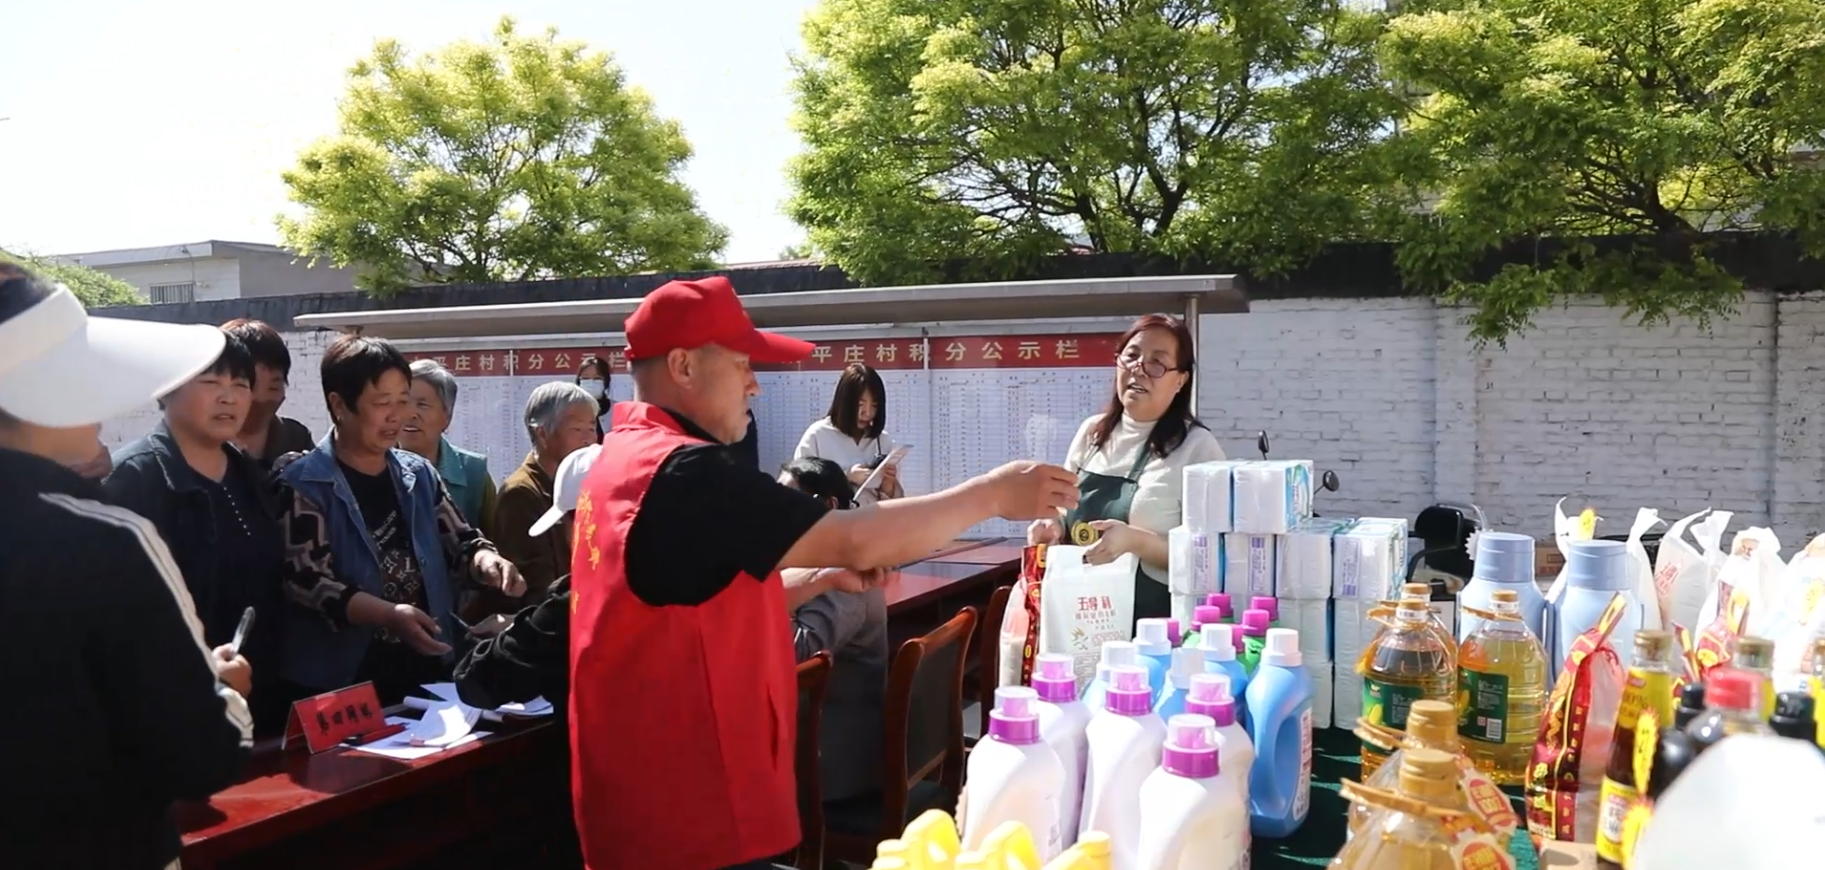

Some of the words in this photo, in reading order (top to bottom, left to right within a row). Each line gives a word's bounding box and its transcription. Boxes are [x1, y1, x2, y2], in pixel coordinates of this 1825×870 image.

[410, 351, 627, 372] 平庄村积分公示栏
[781, 339, 1080, 364] 平庄村积分公示栏
